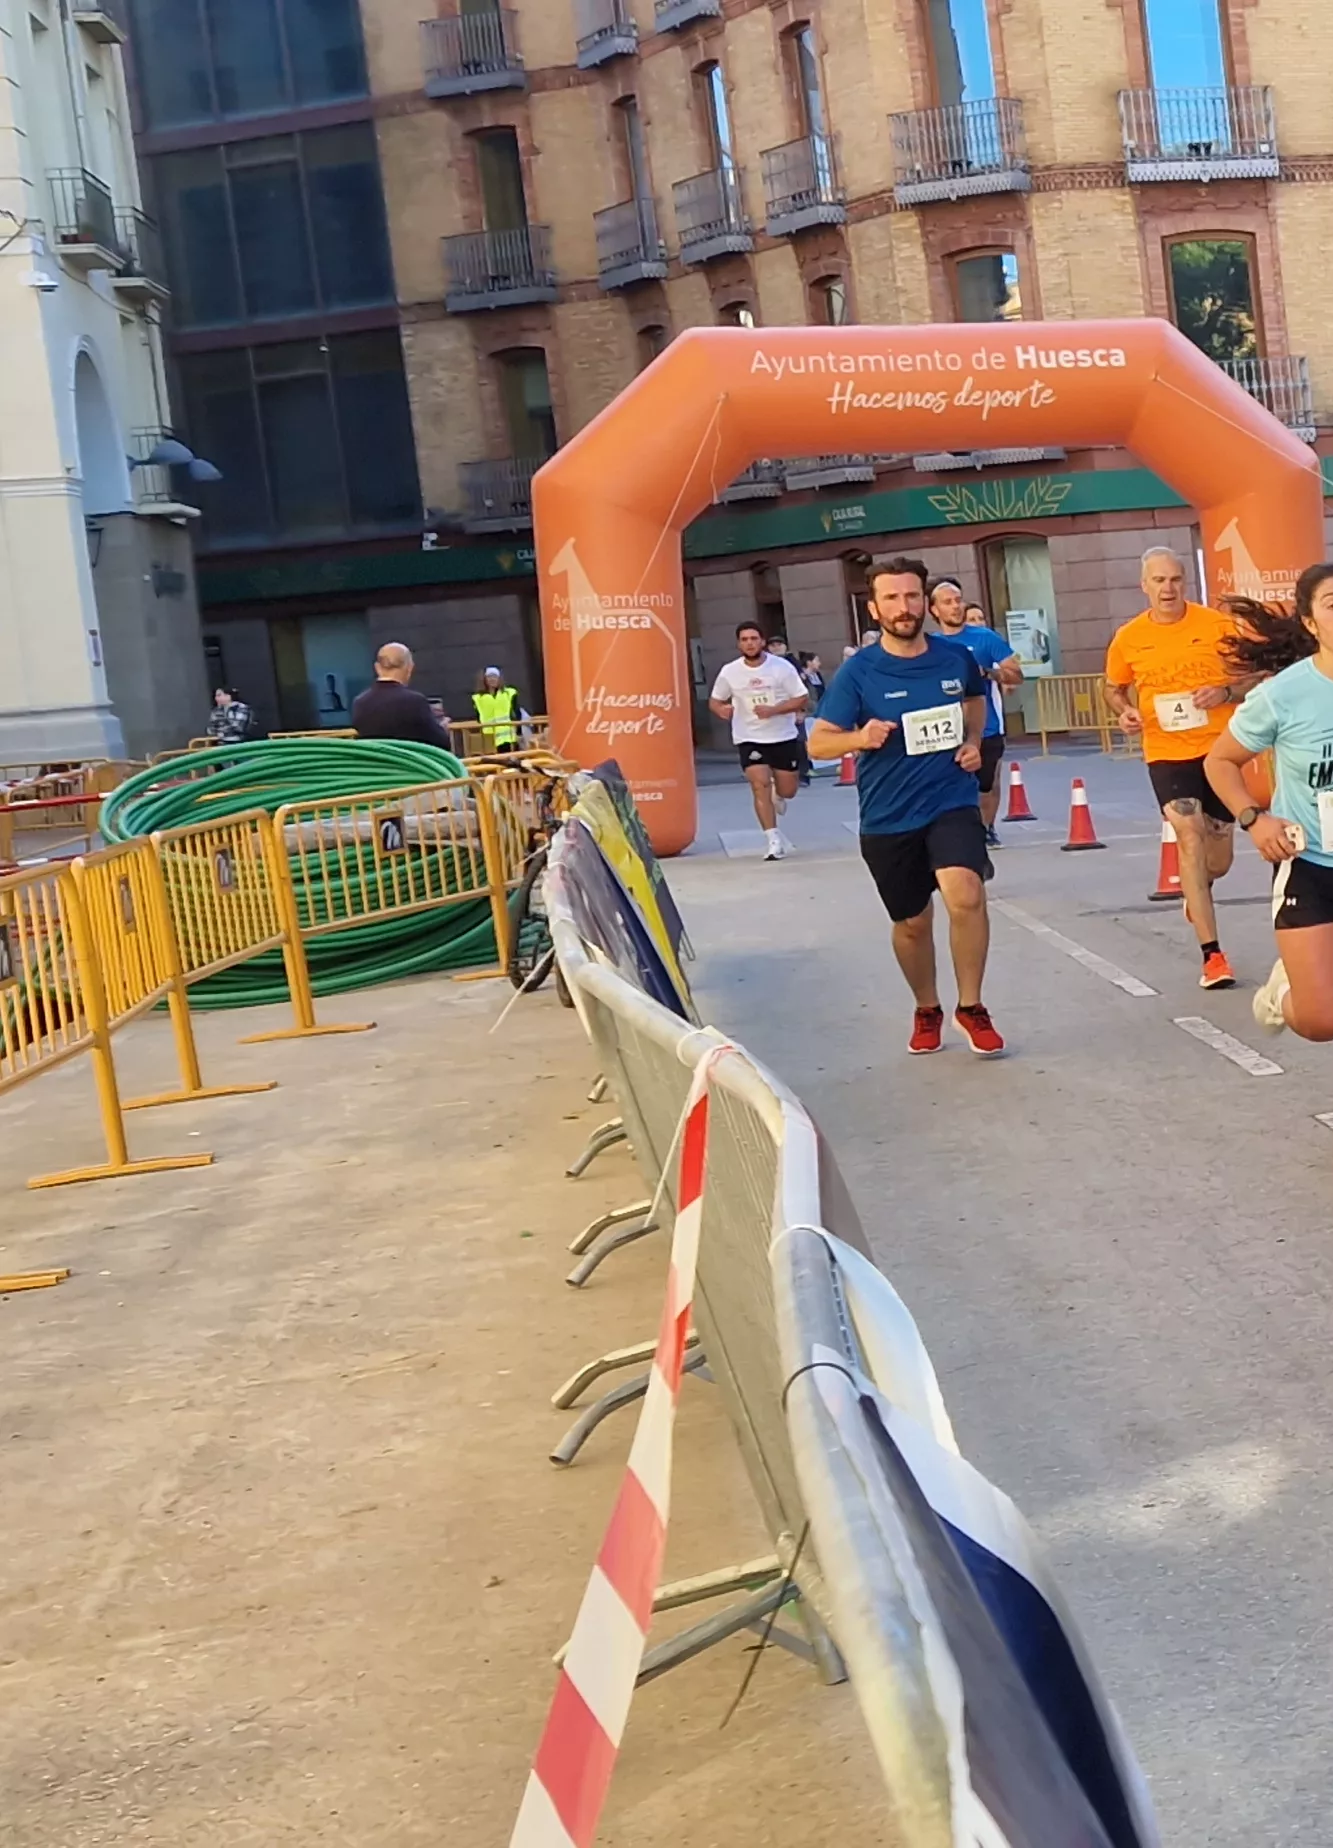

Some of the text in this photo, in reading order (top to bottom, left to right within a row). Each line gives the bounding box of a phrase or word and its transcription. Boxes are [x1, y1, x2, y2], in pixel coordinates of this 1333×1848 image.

[750, 345, 1126, 380] Ayuntamiento de Huesca
[827, 376, 1057, 420] Hacemos deporte
[552, 592, 674, 613] Ayuntamiento
[554, 613, 652, 631] de Huesca
[583, 686, 675, 710] Hacemos
[1174, 702, 1184, 713] 4
[586, 712, 666, 745] deporte
[920, 721, 953, 737] 112
